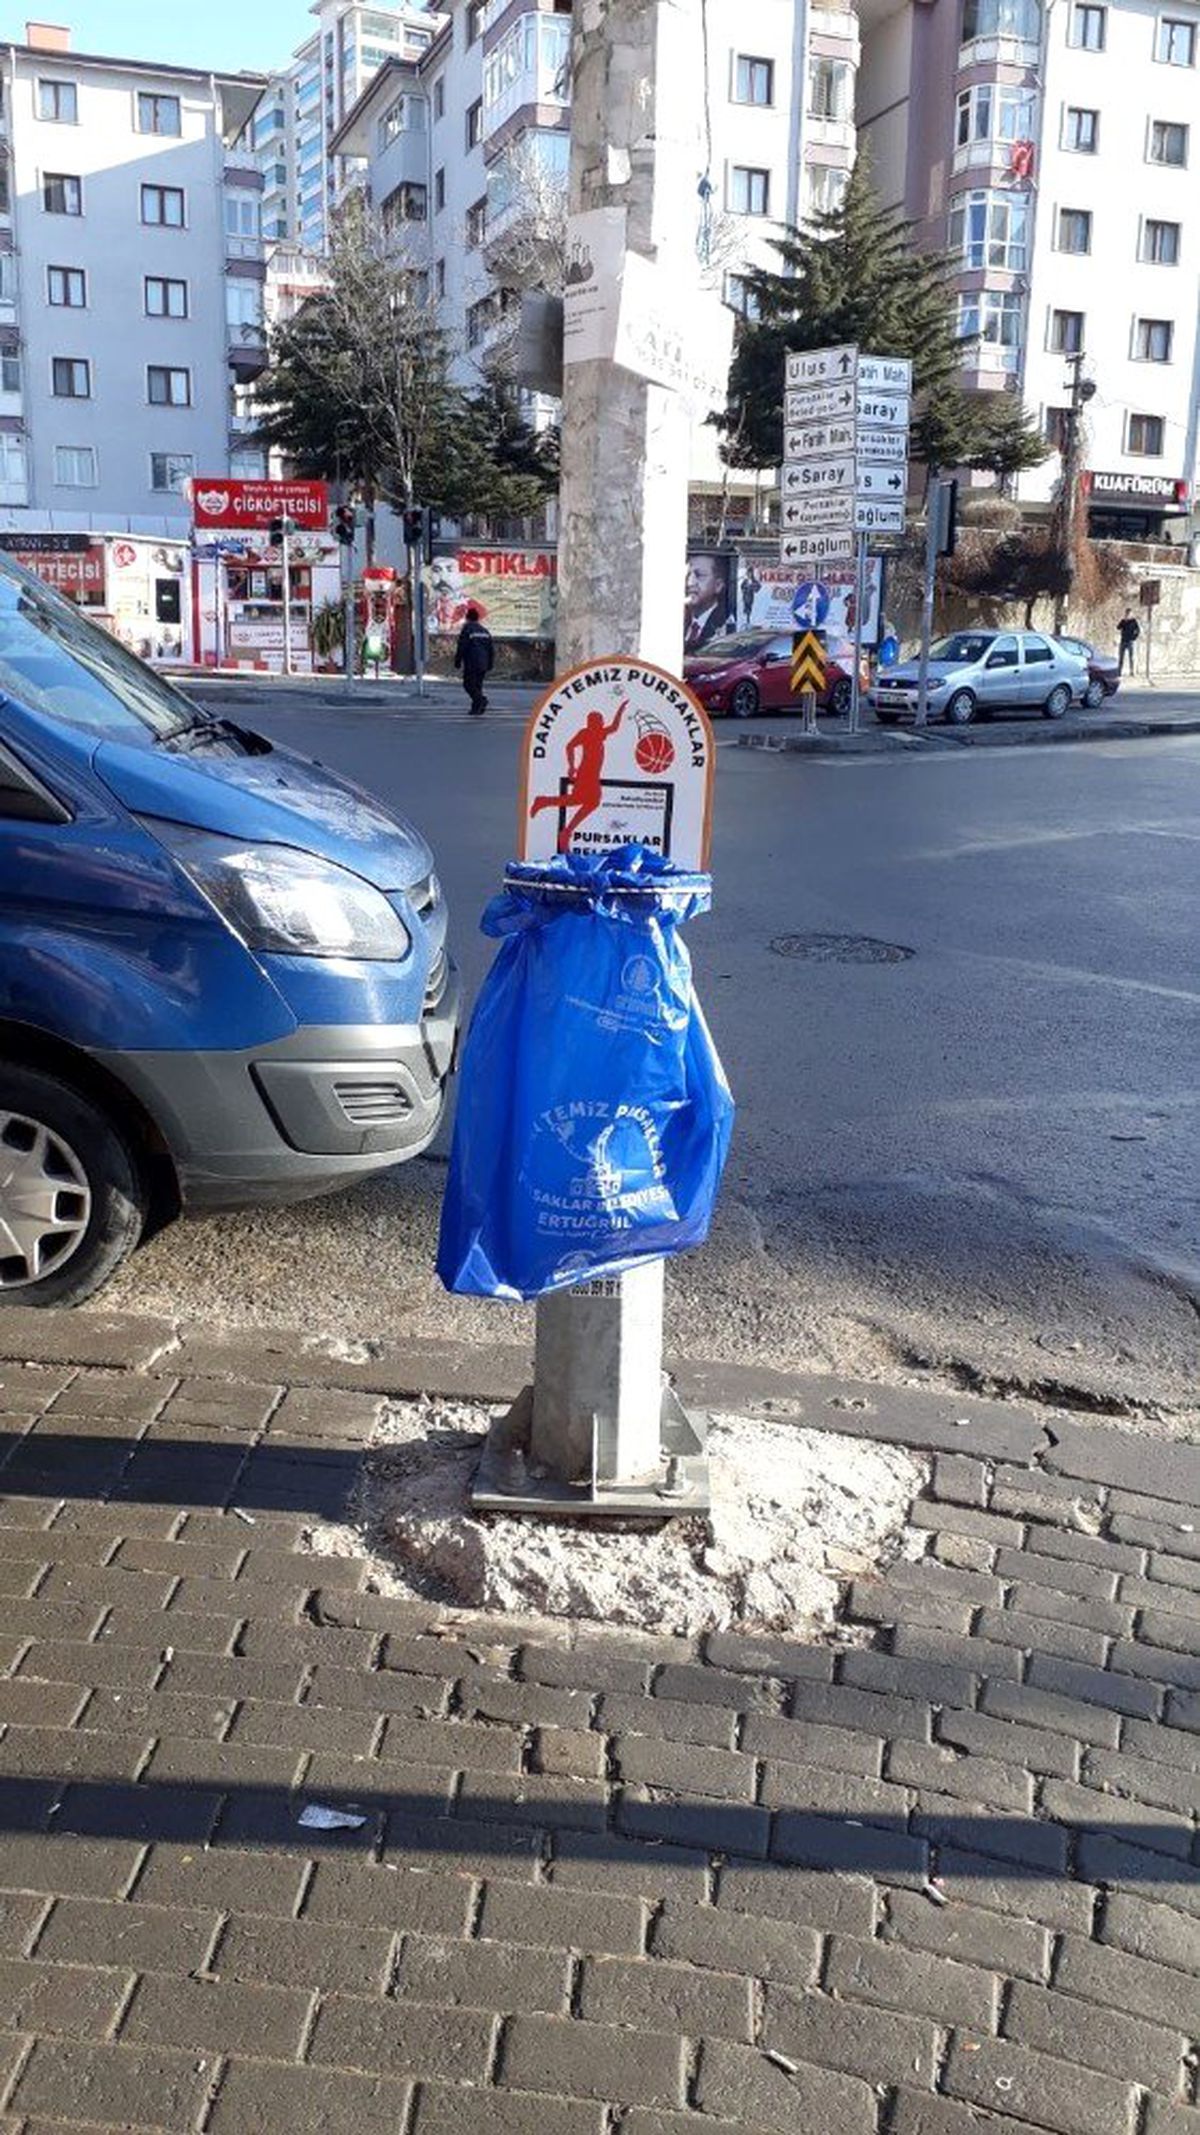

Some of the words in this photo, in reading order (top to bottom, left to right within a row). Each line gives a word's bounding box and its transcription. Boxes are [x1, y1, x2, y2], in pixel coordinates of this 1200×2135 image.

[790, 361, 827, 379] Ulus
[802, 468, 846, 484] Saray
[533, 702, 562, 759] DAHA
[627, 669, 705, 768] PURSAKLAR
[573, 831, 662, 846] PURSAKLAR
